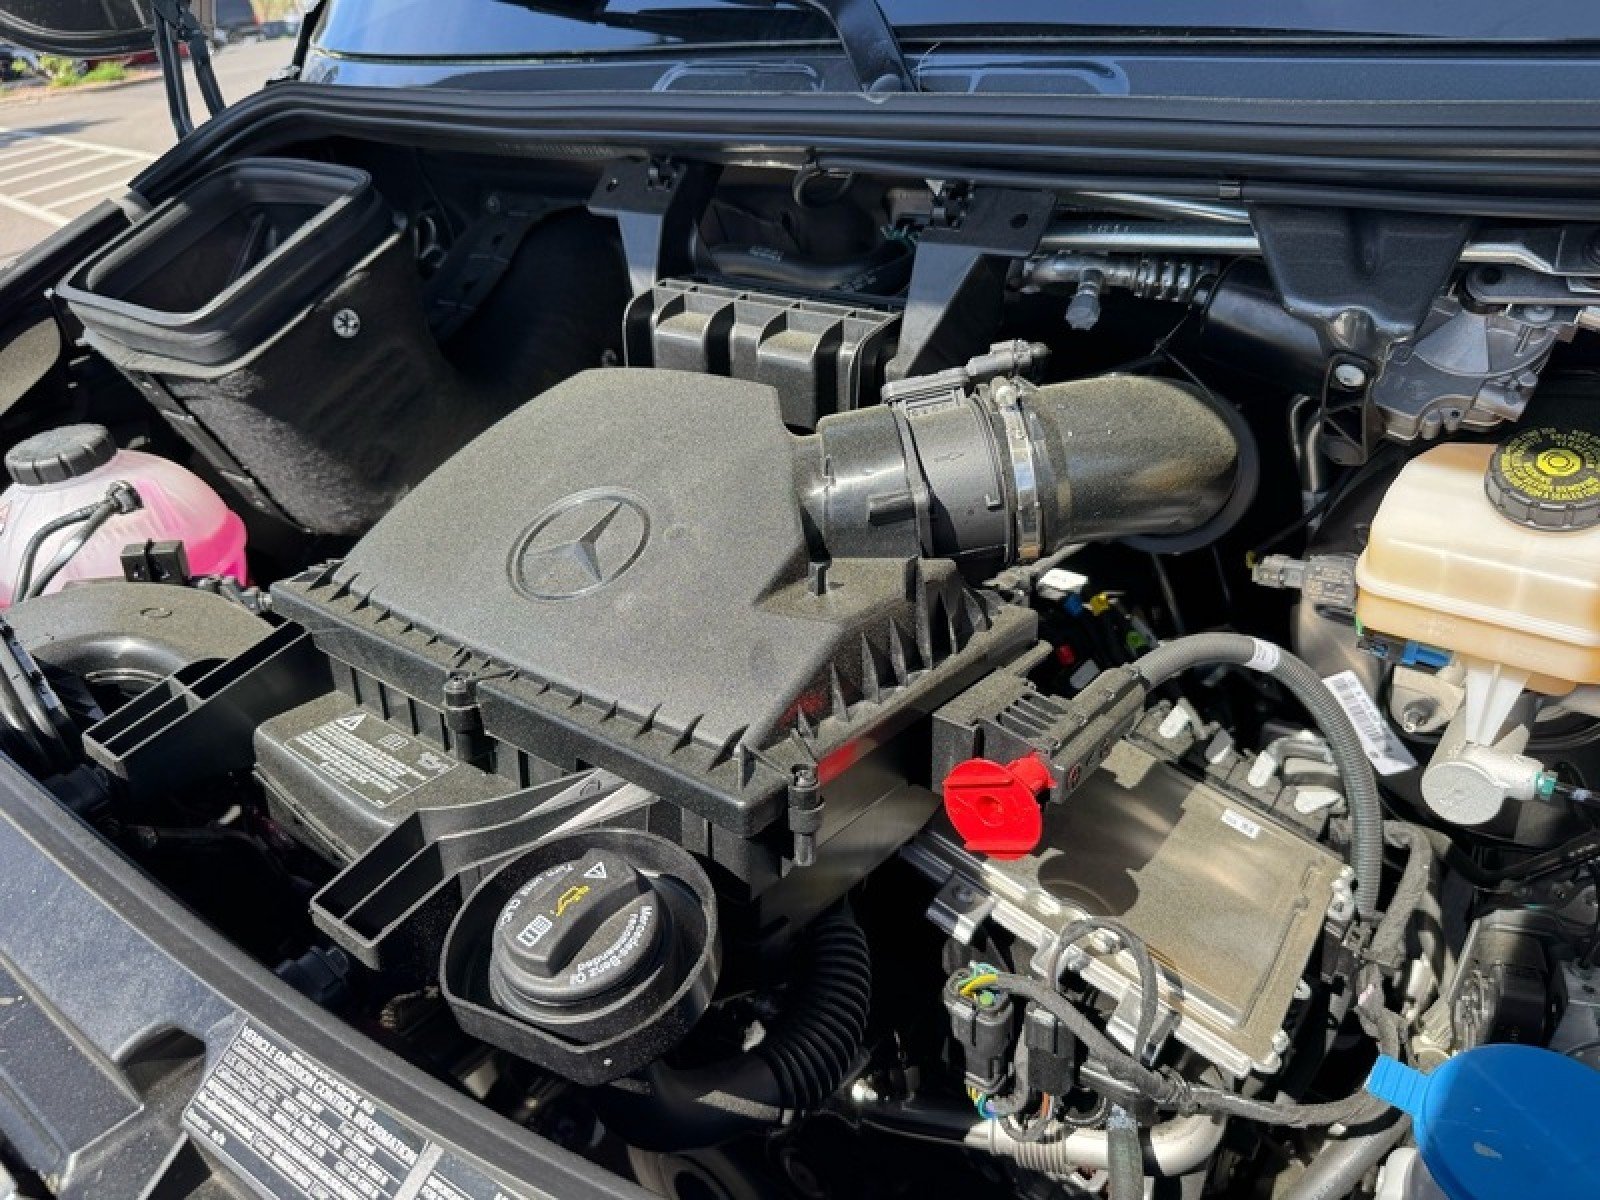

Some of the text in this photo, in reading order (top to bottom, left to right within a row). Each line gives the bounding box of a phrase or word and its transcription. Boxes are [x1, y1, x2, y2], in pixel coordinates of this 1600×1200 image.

[242, 1026, 419, 1166] VEHICLE EMISSION CONTROL INFORMATION
